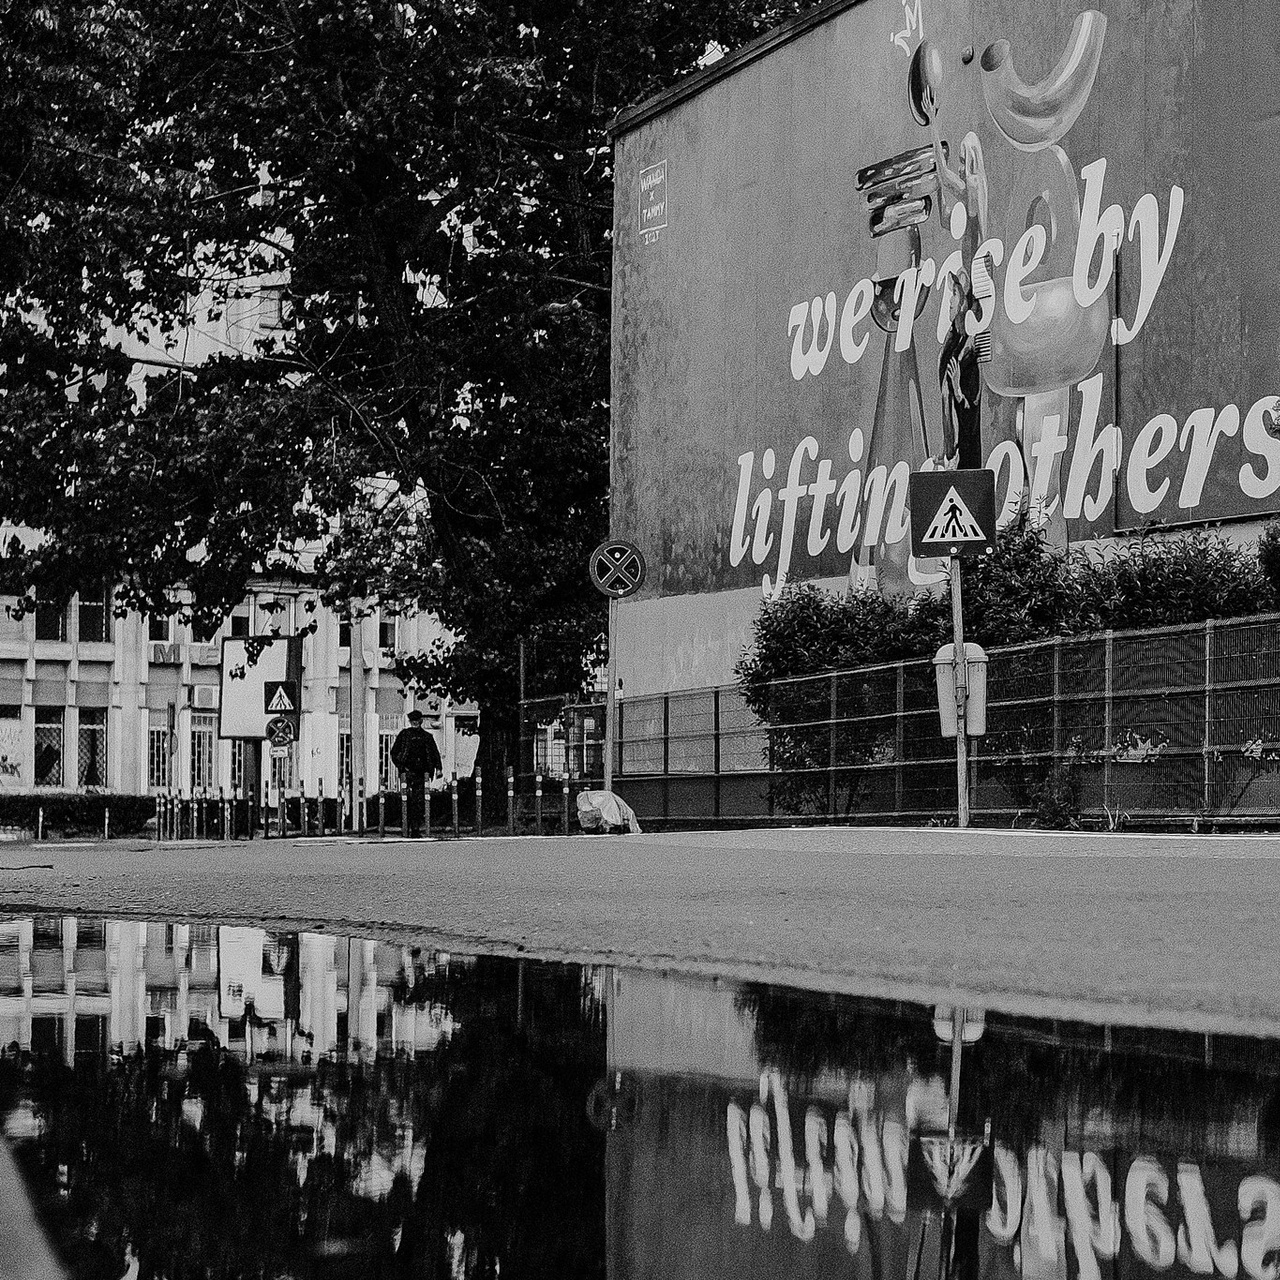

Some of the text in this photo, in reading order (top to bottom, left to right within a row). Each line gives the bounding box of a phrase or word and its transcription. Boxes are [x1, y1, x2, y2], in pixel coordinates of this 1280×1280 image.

[787, 157, 1185, 381] we rise by
[729, 427, 953, 602] liftin
